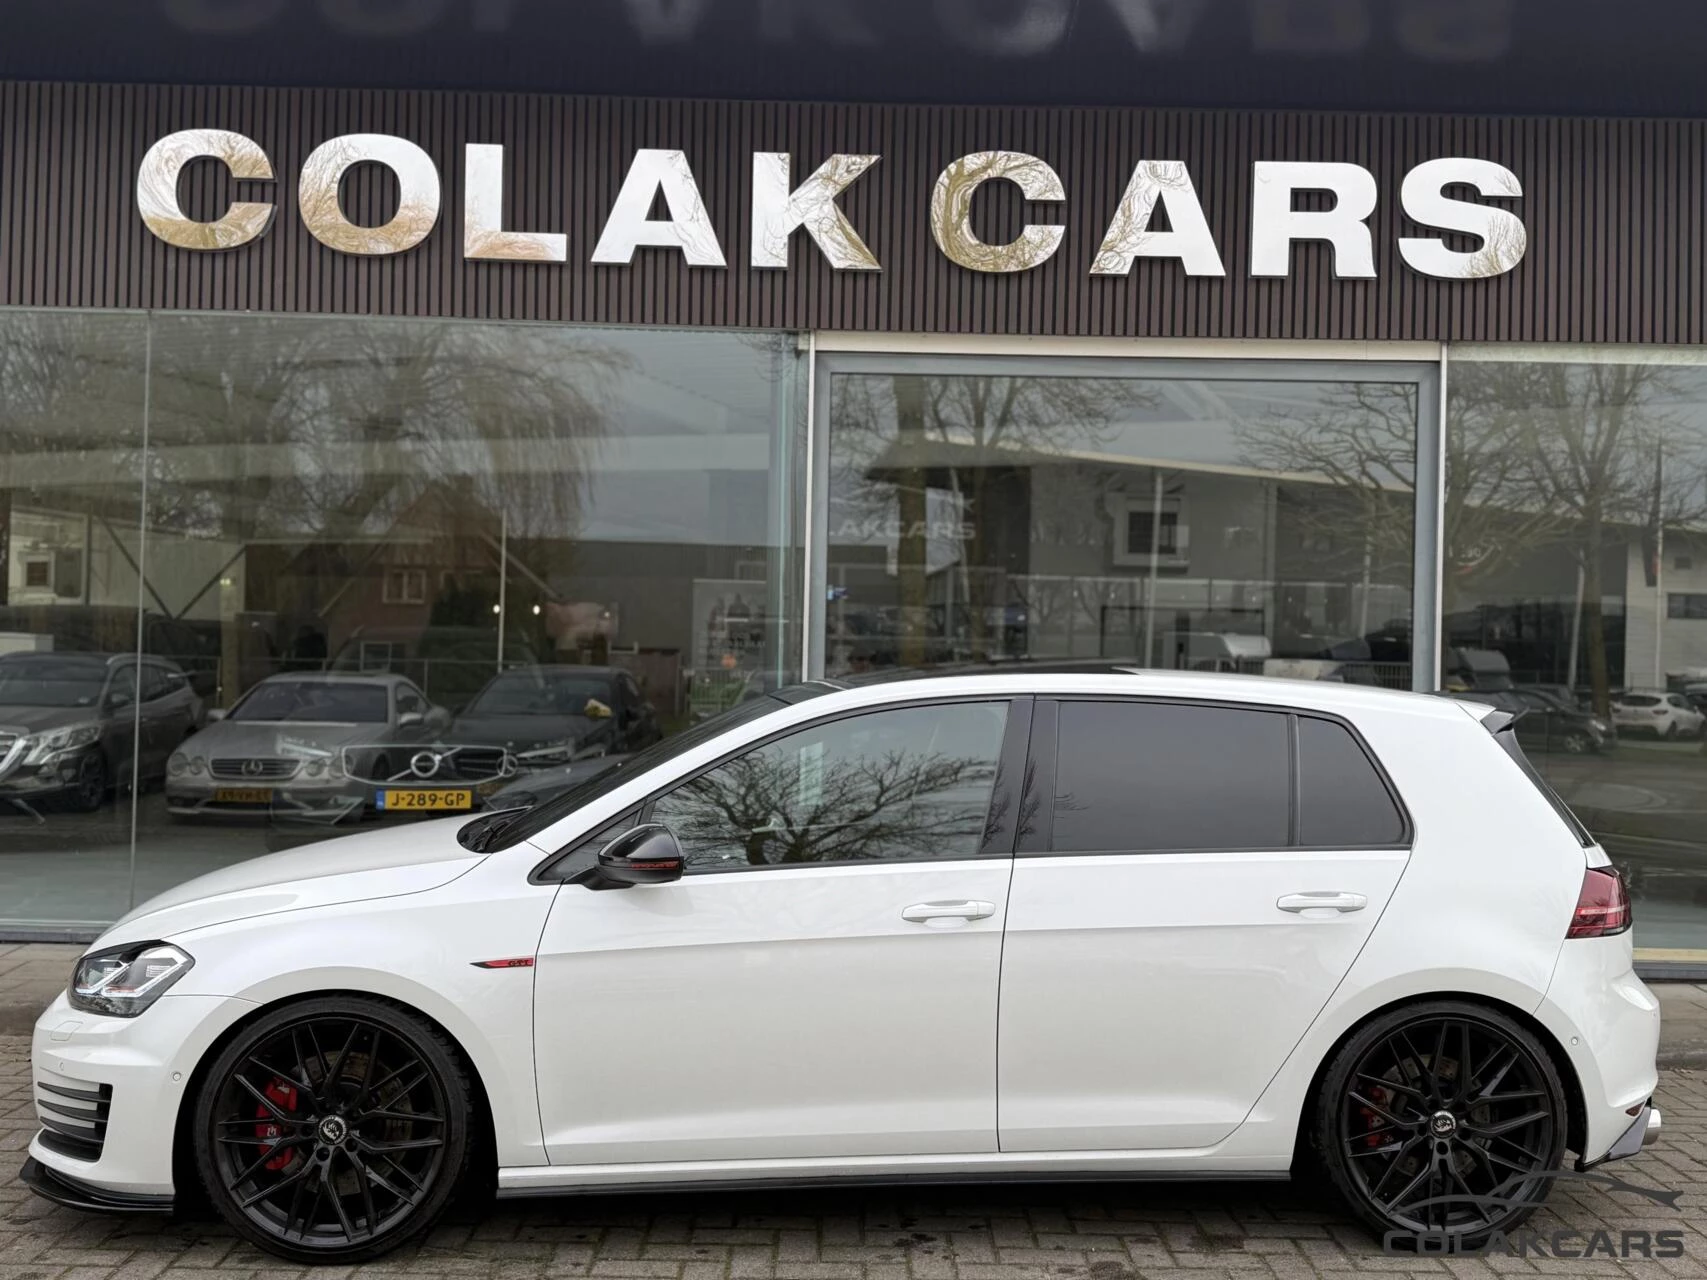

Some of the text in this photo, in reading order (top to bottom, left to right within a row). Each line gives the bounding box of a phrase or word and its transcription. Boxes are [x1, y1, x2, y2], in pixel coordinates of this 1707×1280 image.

[136, 128, 1528, 280] COLAK CARS
[391, 792, 466, 807] J-289-GP
